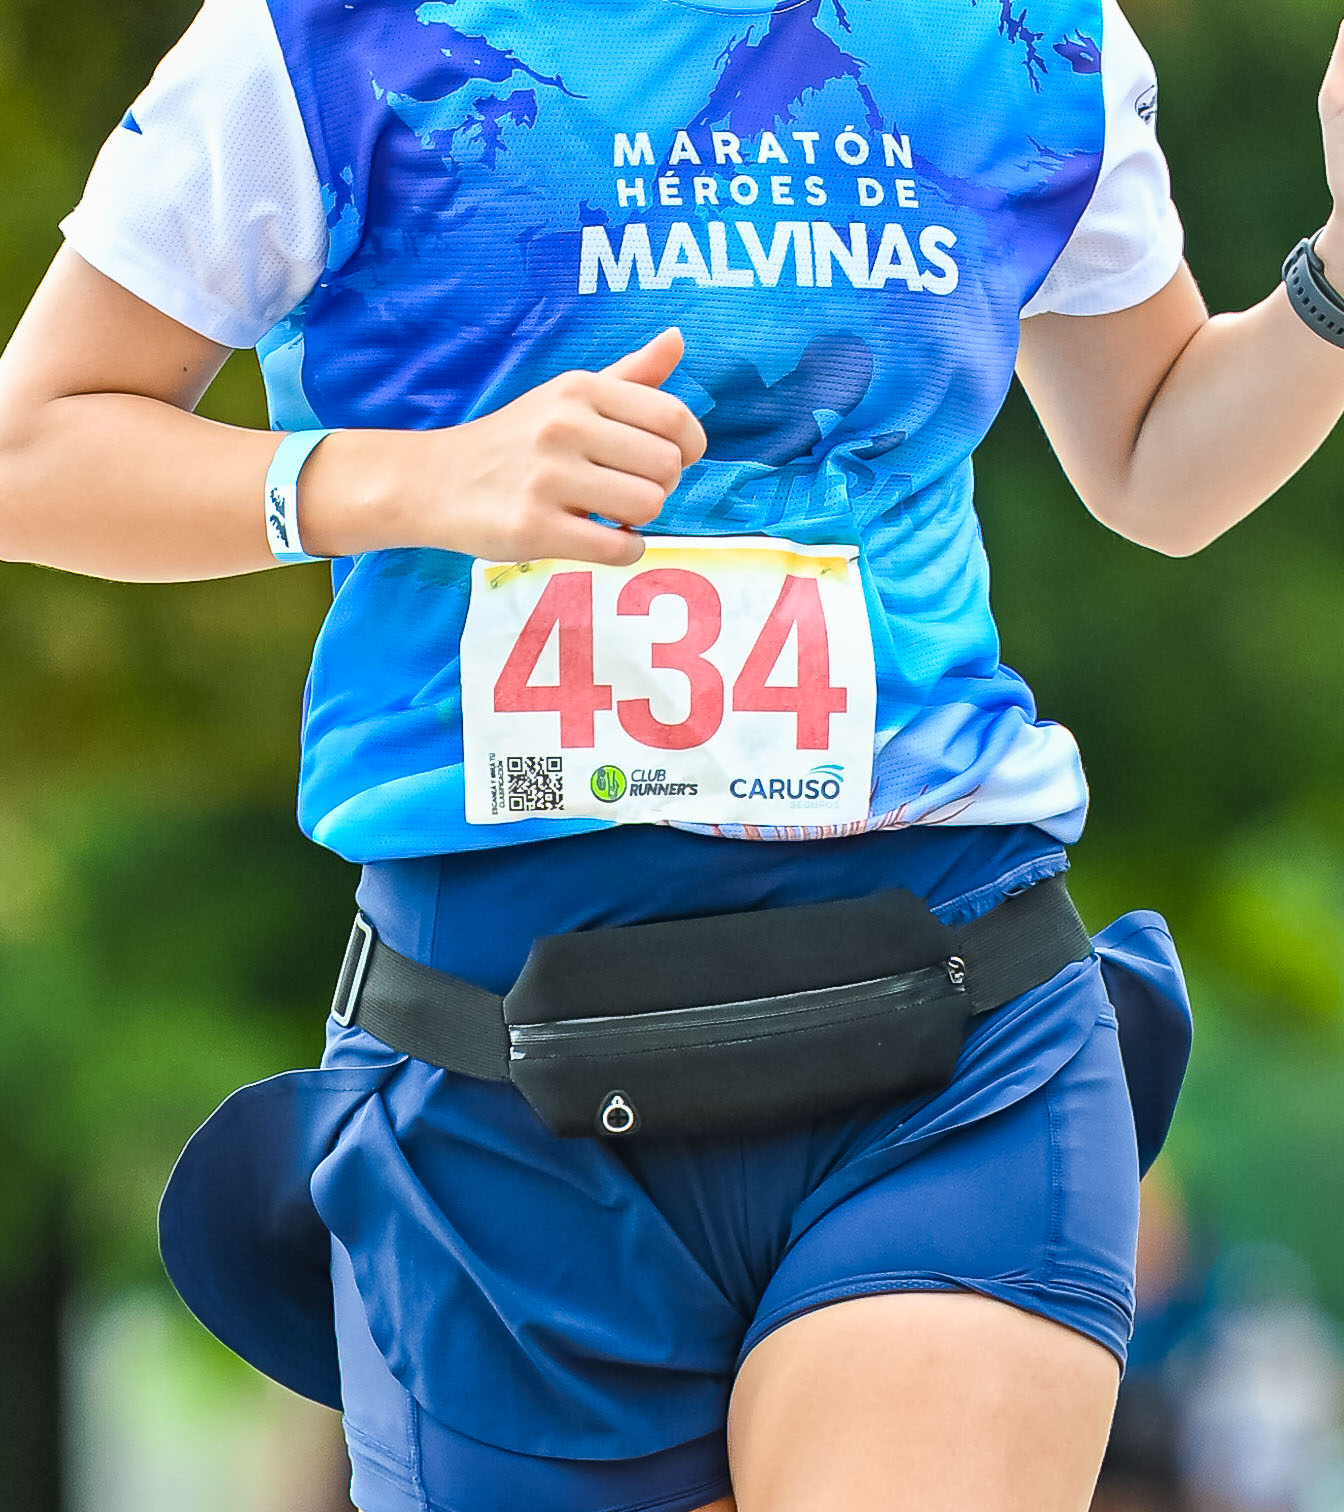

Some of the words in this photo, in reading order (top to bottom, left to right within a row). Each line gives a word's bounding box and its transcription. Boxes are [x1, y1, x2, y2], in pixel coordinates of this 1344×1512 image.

[612, 124, 914, 170] MARATÓN
[616, 169, 828, 208] HÉROES
[857, 177, 920, 209] DE
[577, 220, 959, 296] MALVINAS
[493, 567, 847, 751] 434
[629, 783, 699, 797] RUNNER'S
[630, 769, 667, 782] CLUB
[729, 778, 841, 800] CARUSO
